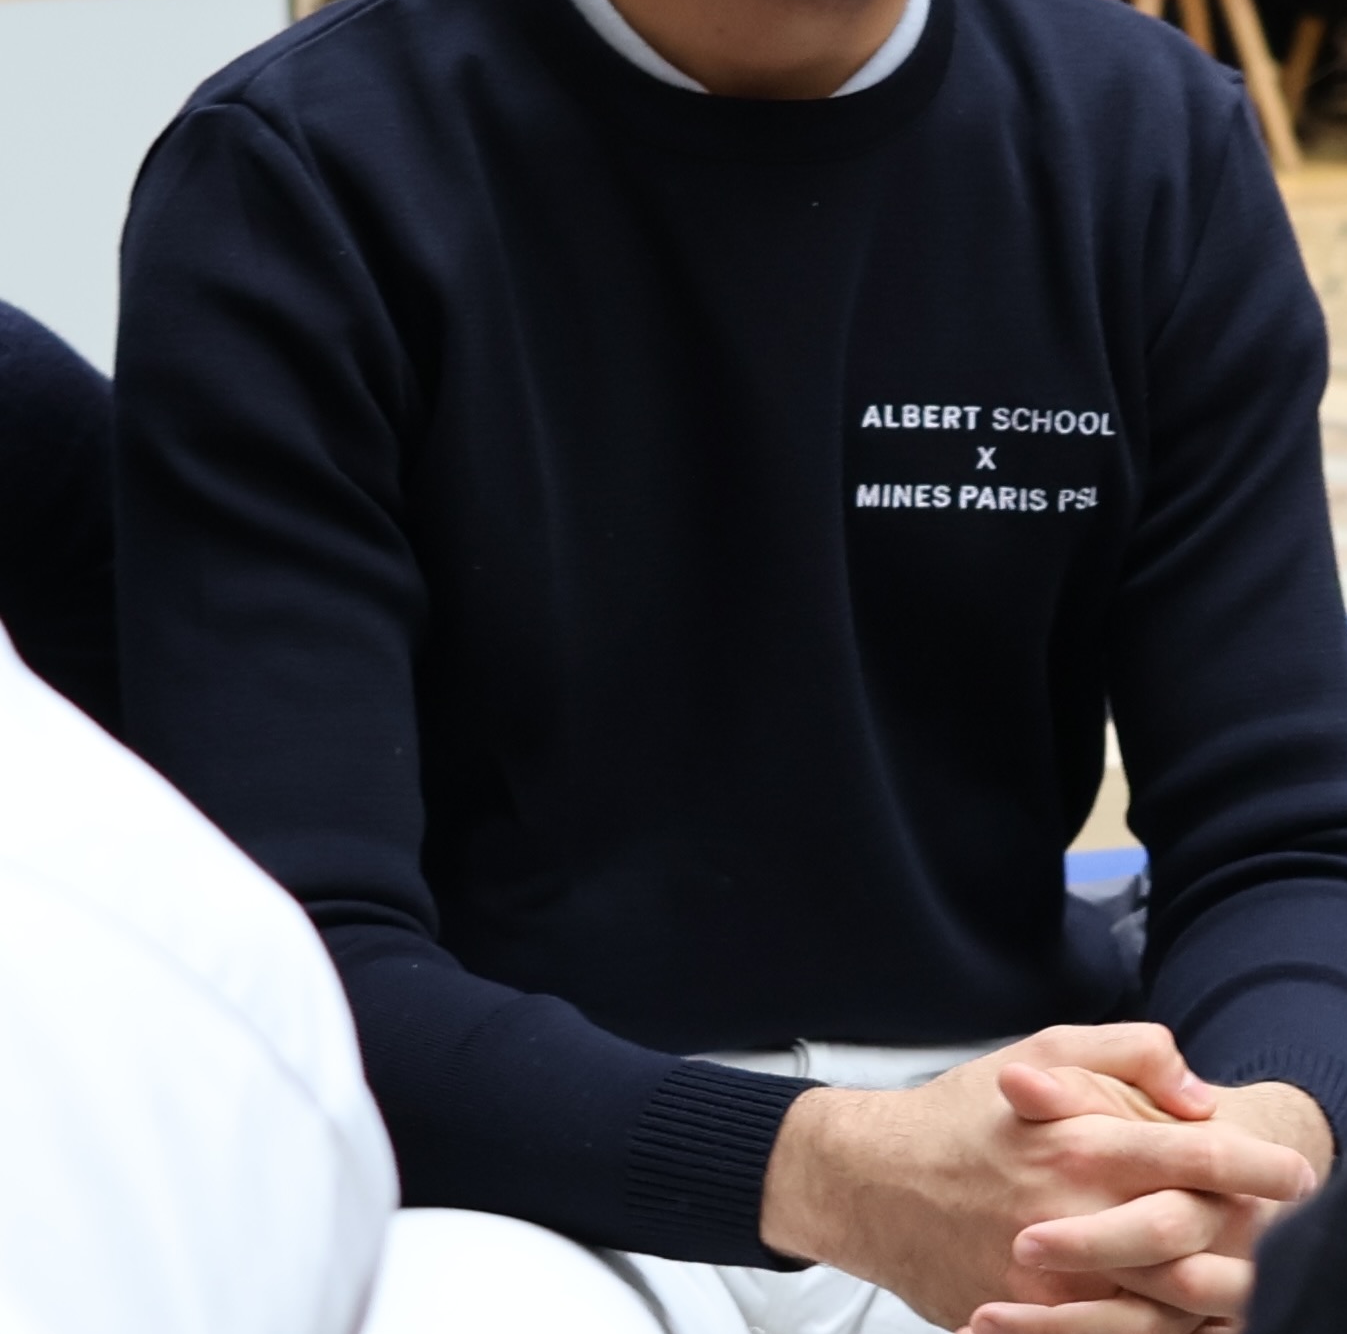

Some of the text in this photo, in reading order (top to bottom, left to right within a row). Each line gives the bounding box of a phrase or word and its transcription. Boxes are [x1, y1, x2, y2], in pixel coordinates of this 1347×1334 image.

[861, 404, 1116, 436] ALBERT SCHOOL
[856, 484, 951, 508] MINES
[959, 485, 1048, 511] PARIS
